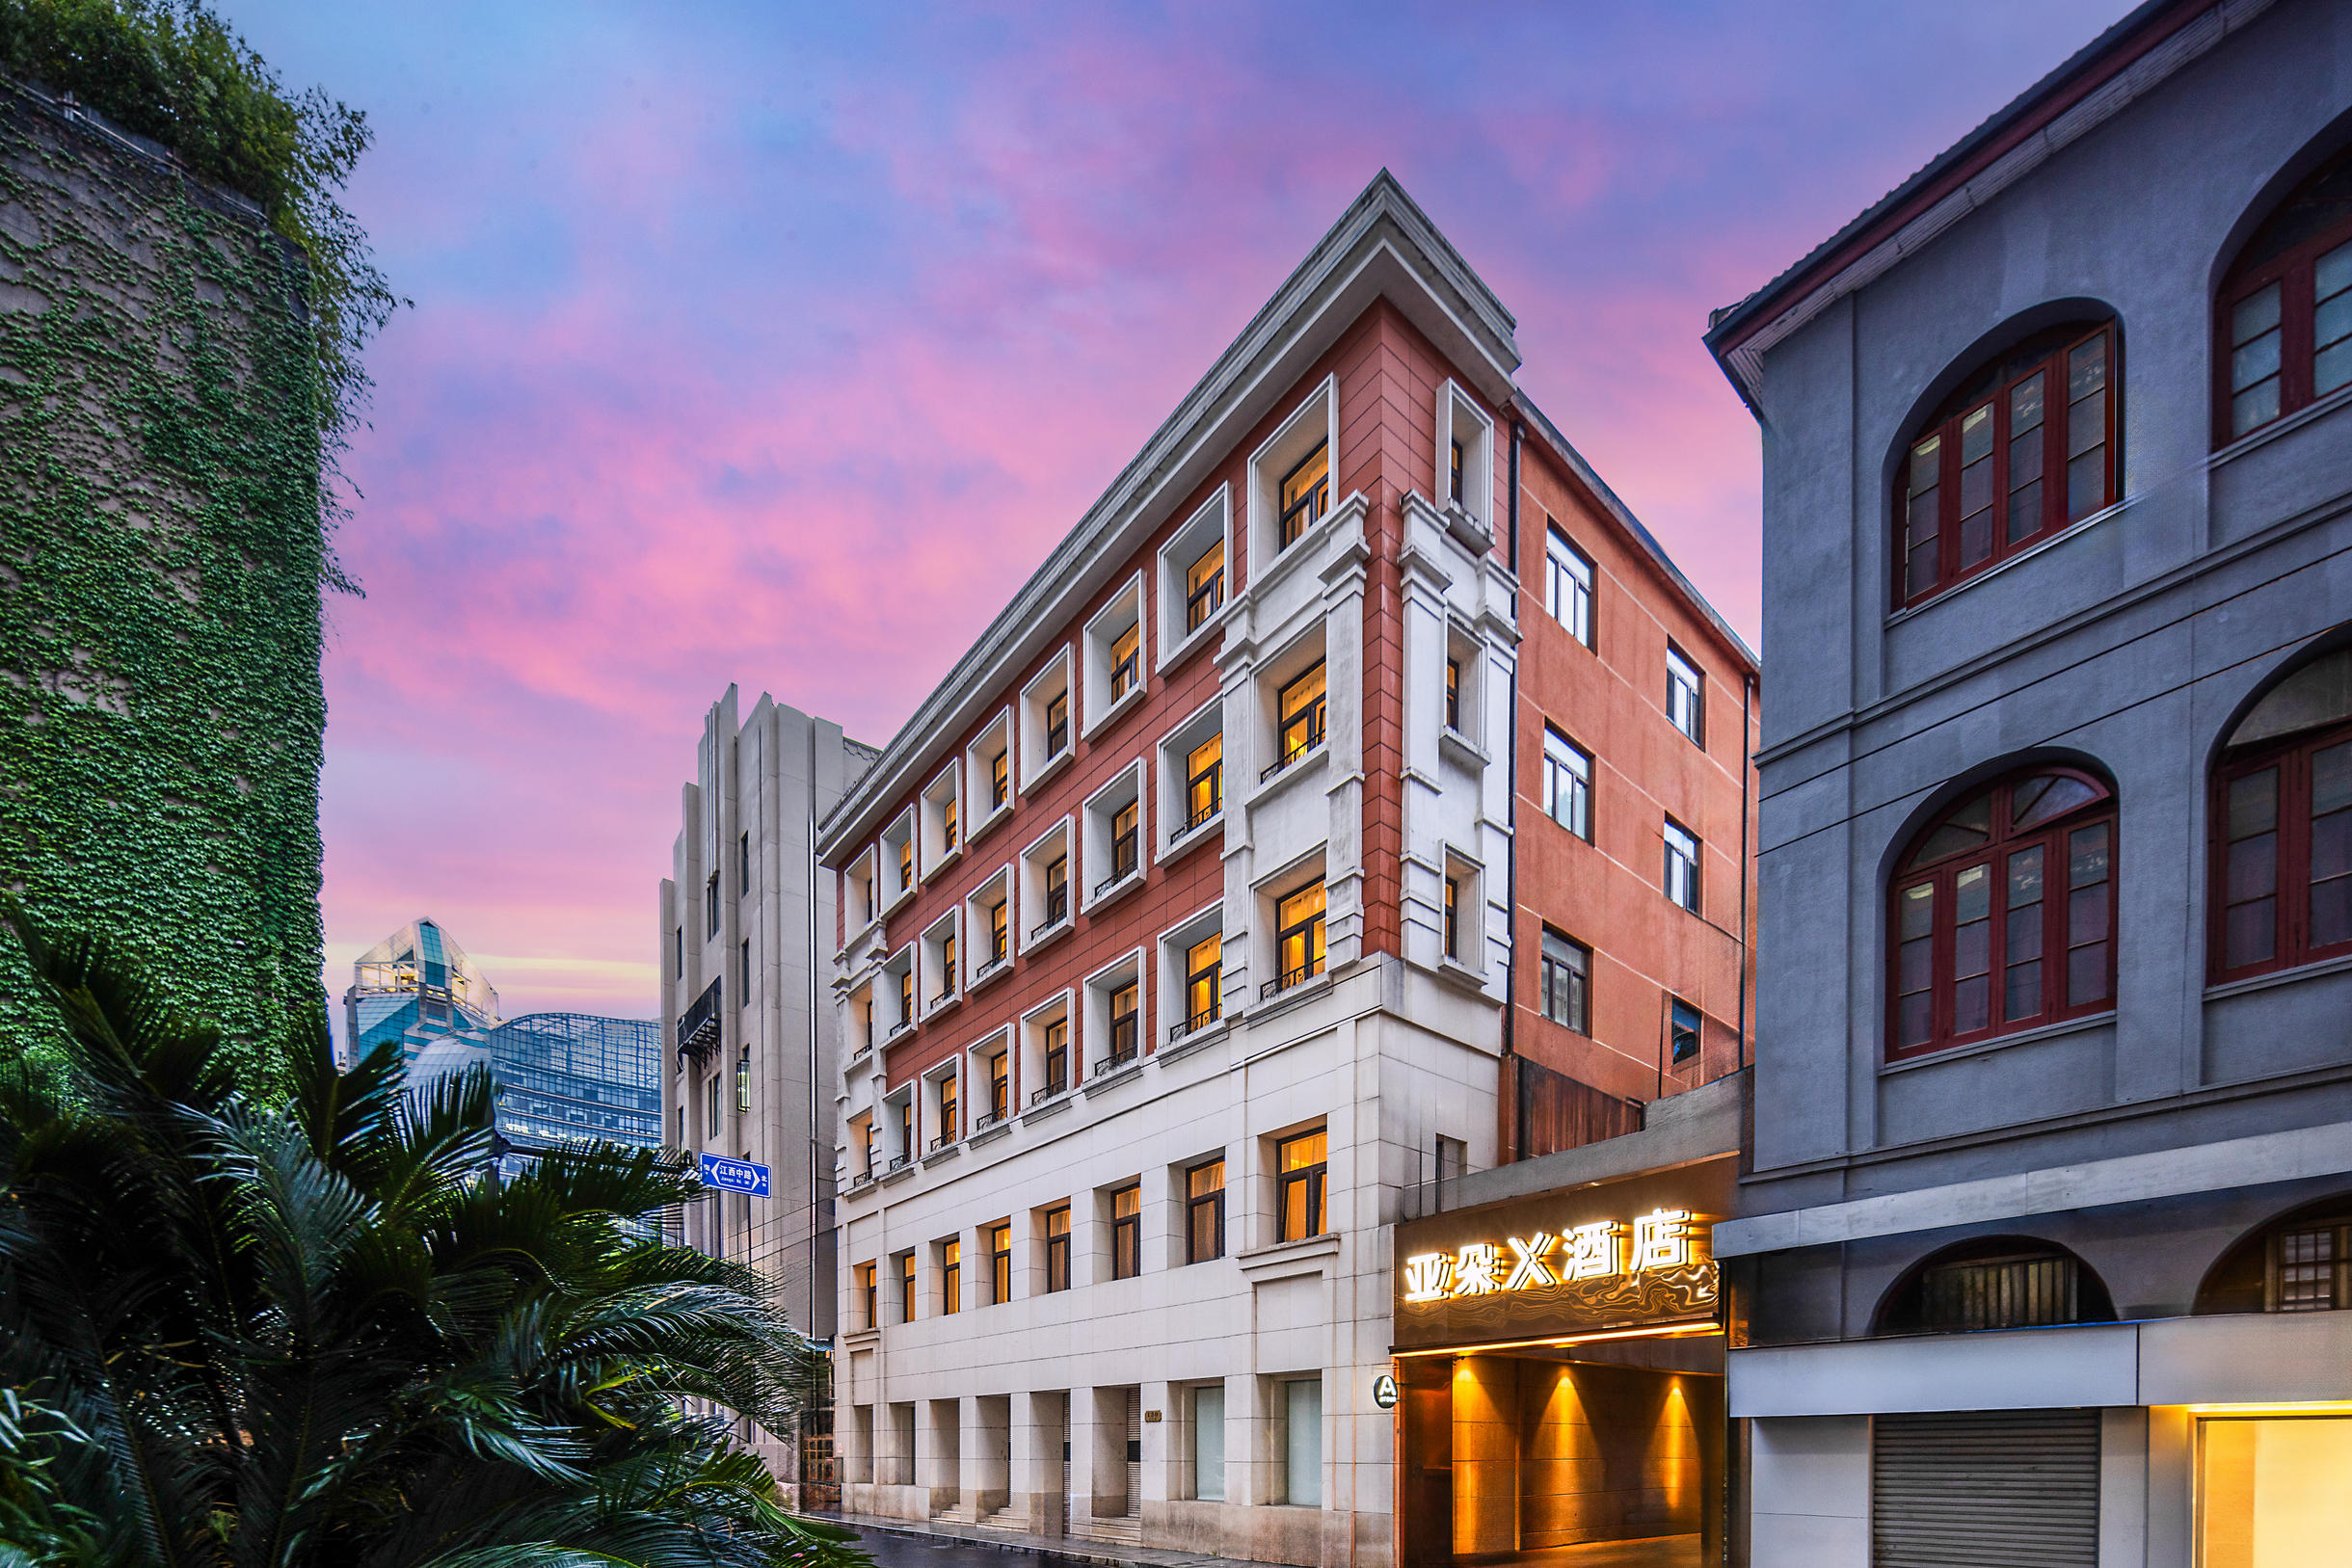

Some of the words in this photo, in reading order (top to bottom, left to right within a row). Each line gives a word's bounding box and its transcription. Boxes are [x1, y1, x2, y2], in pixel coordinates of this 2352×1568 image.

[719, 1165, 752, 1180] 江西中路
[1404, 1208, 1692, 1301] 亚朵X酒店
